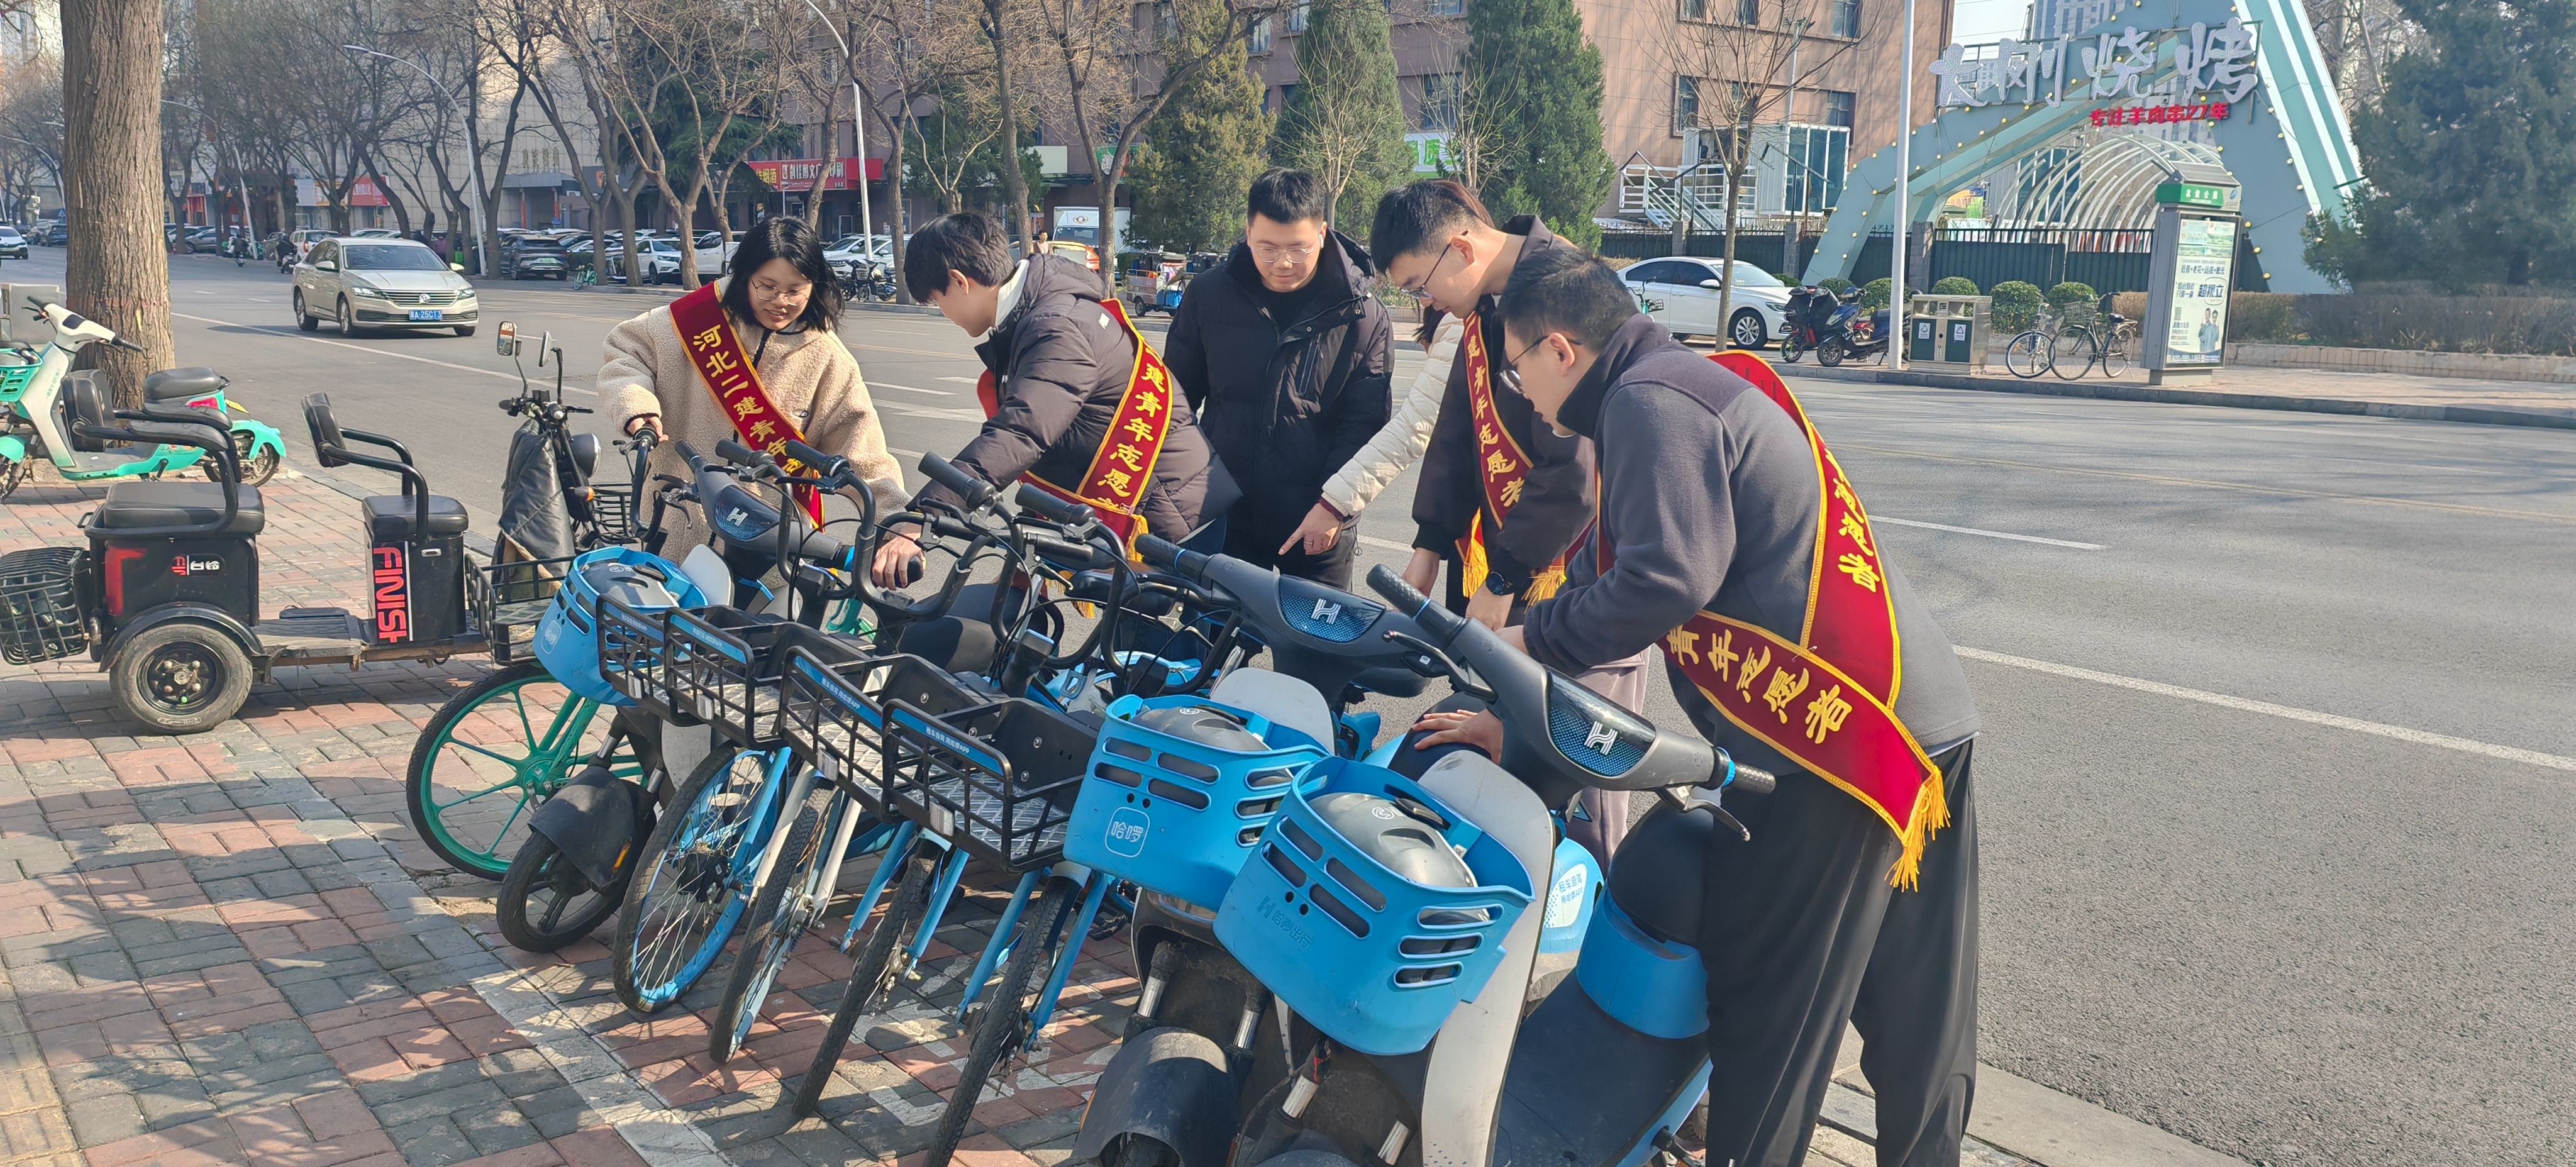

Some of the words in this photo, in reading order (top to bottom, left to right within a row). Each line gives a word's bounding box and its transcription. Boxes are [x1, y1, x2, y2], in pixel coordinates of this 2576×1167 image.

[1928, 17, 2258, 108] 大刚烧烤
[2089, 101, 2229, 127] 专注羊肉串27年
[1667, 624, 1852, 744] 青年志愿者
[1111, 821, 1143, 843] 哈啰
